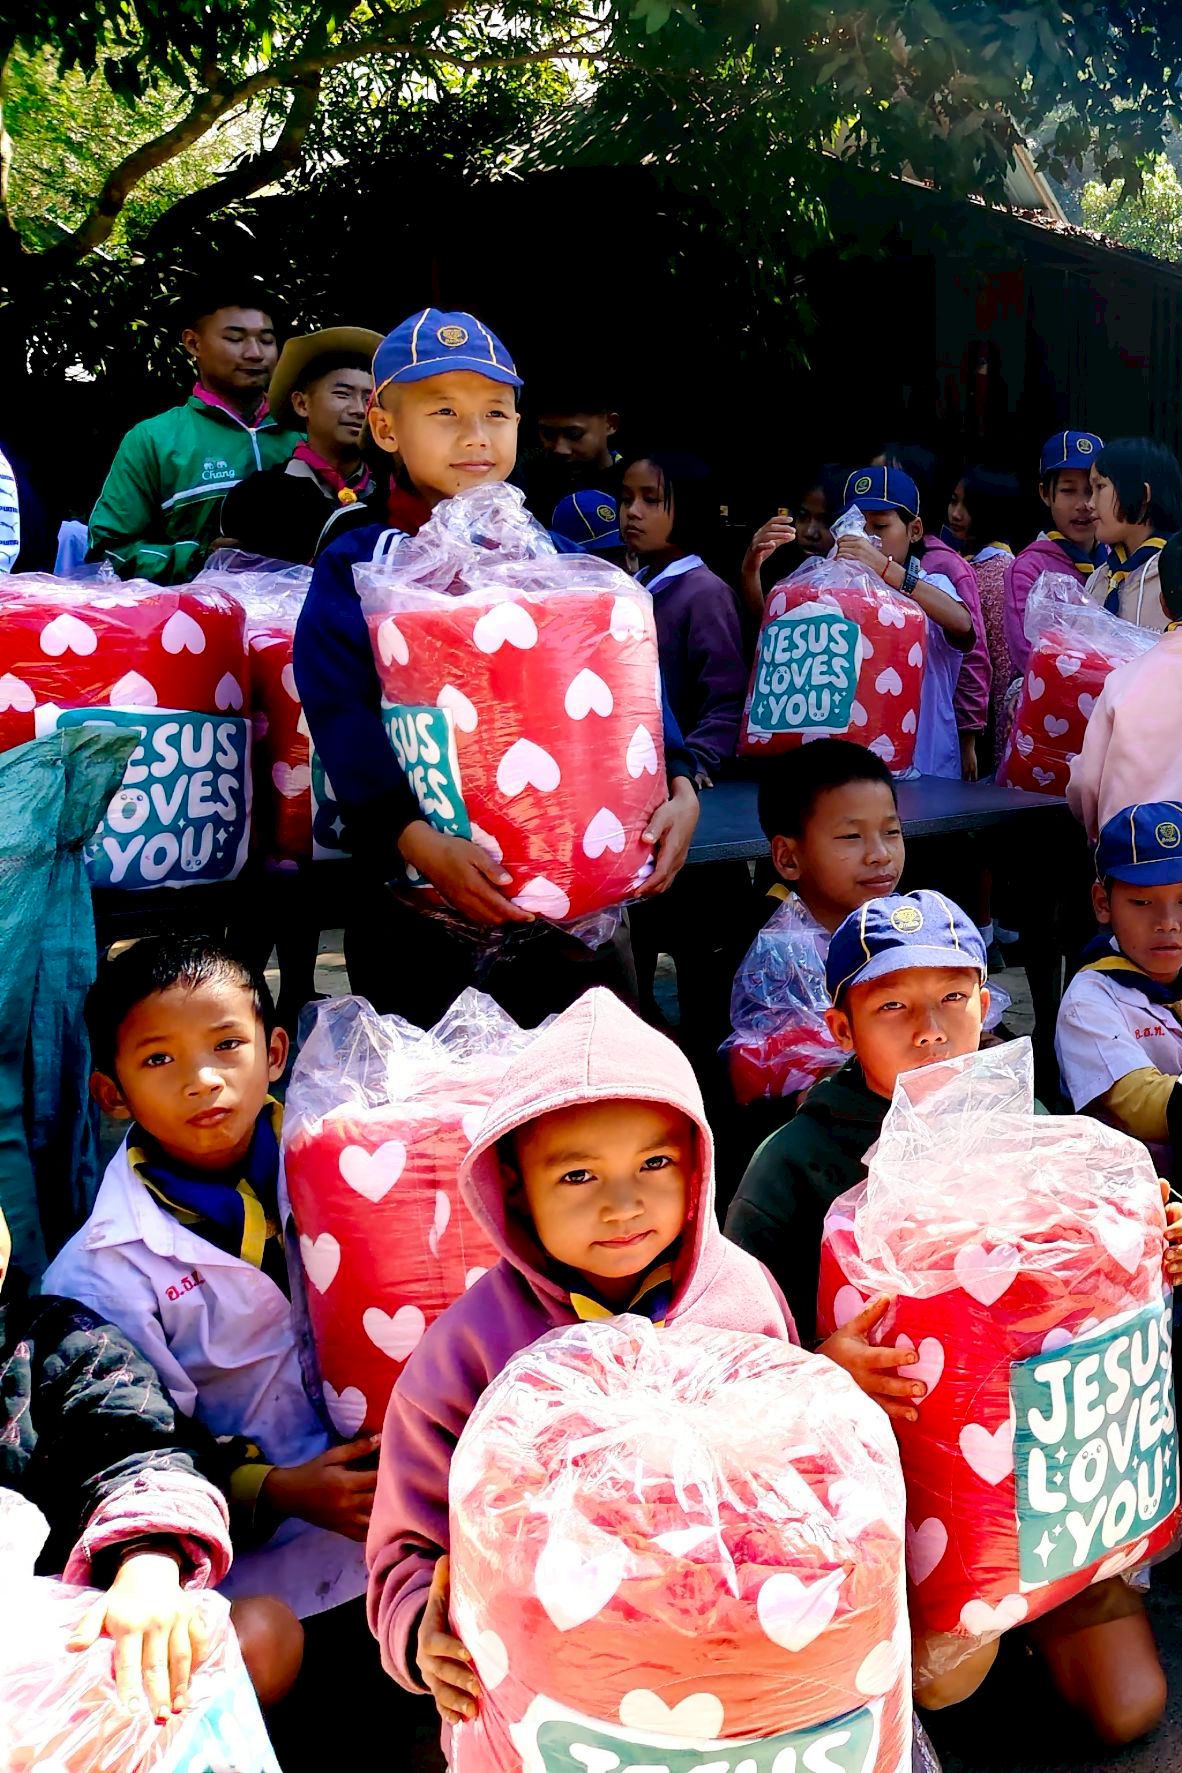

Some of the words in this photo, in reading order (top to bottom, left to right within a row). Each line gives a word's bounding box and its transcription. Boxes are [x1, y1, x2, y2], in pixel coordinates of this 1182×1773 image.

[201, 469, 236, 480] Chang
[763, 622, 849, 664] JESUS
[758, 654, 850, 694] LOVES
[769, 688, 831, 725] YOU
[121, 722, 239, 785] ESUS
[97, 771, 240, 833] OVES
[102, 822, 214, 883] YOU
[1027, 1308, 1172, 1445] JESUS
[1028, 1366, 1175, 1513] LOVES
[1065, 1447, 1162, 1567] YOU
